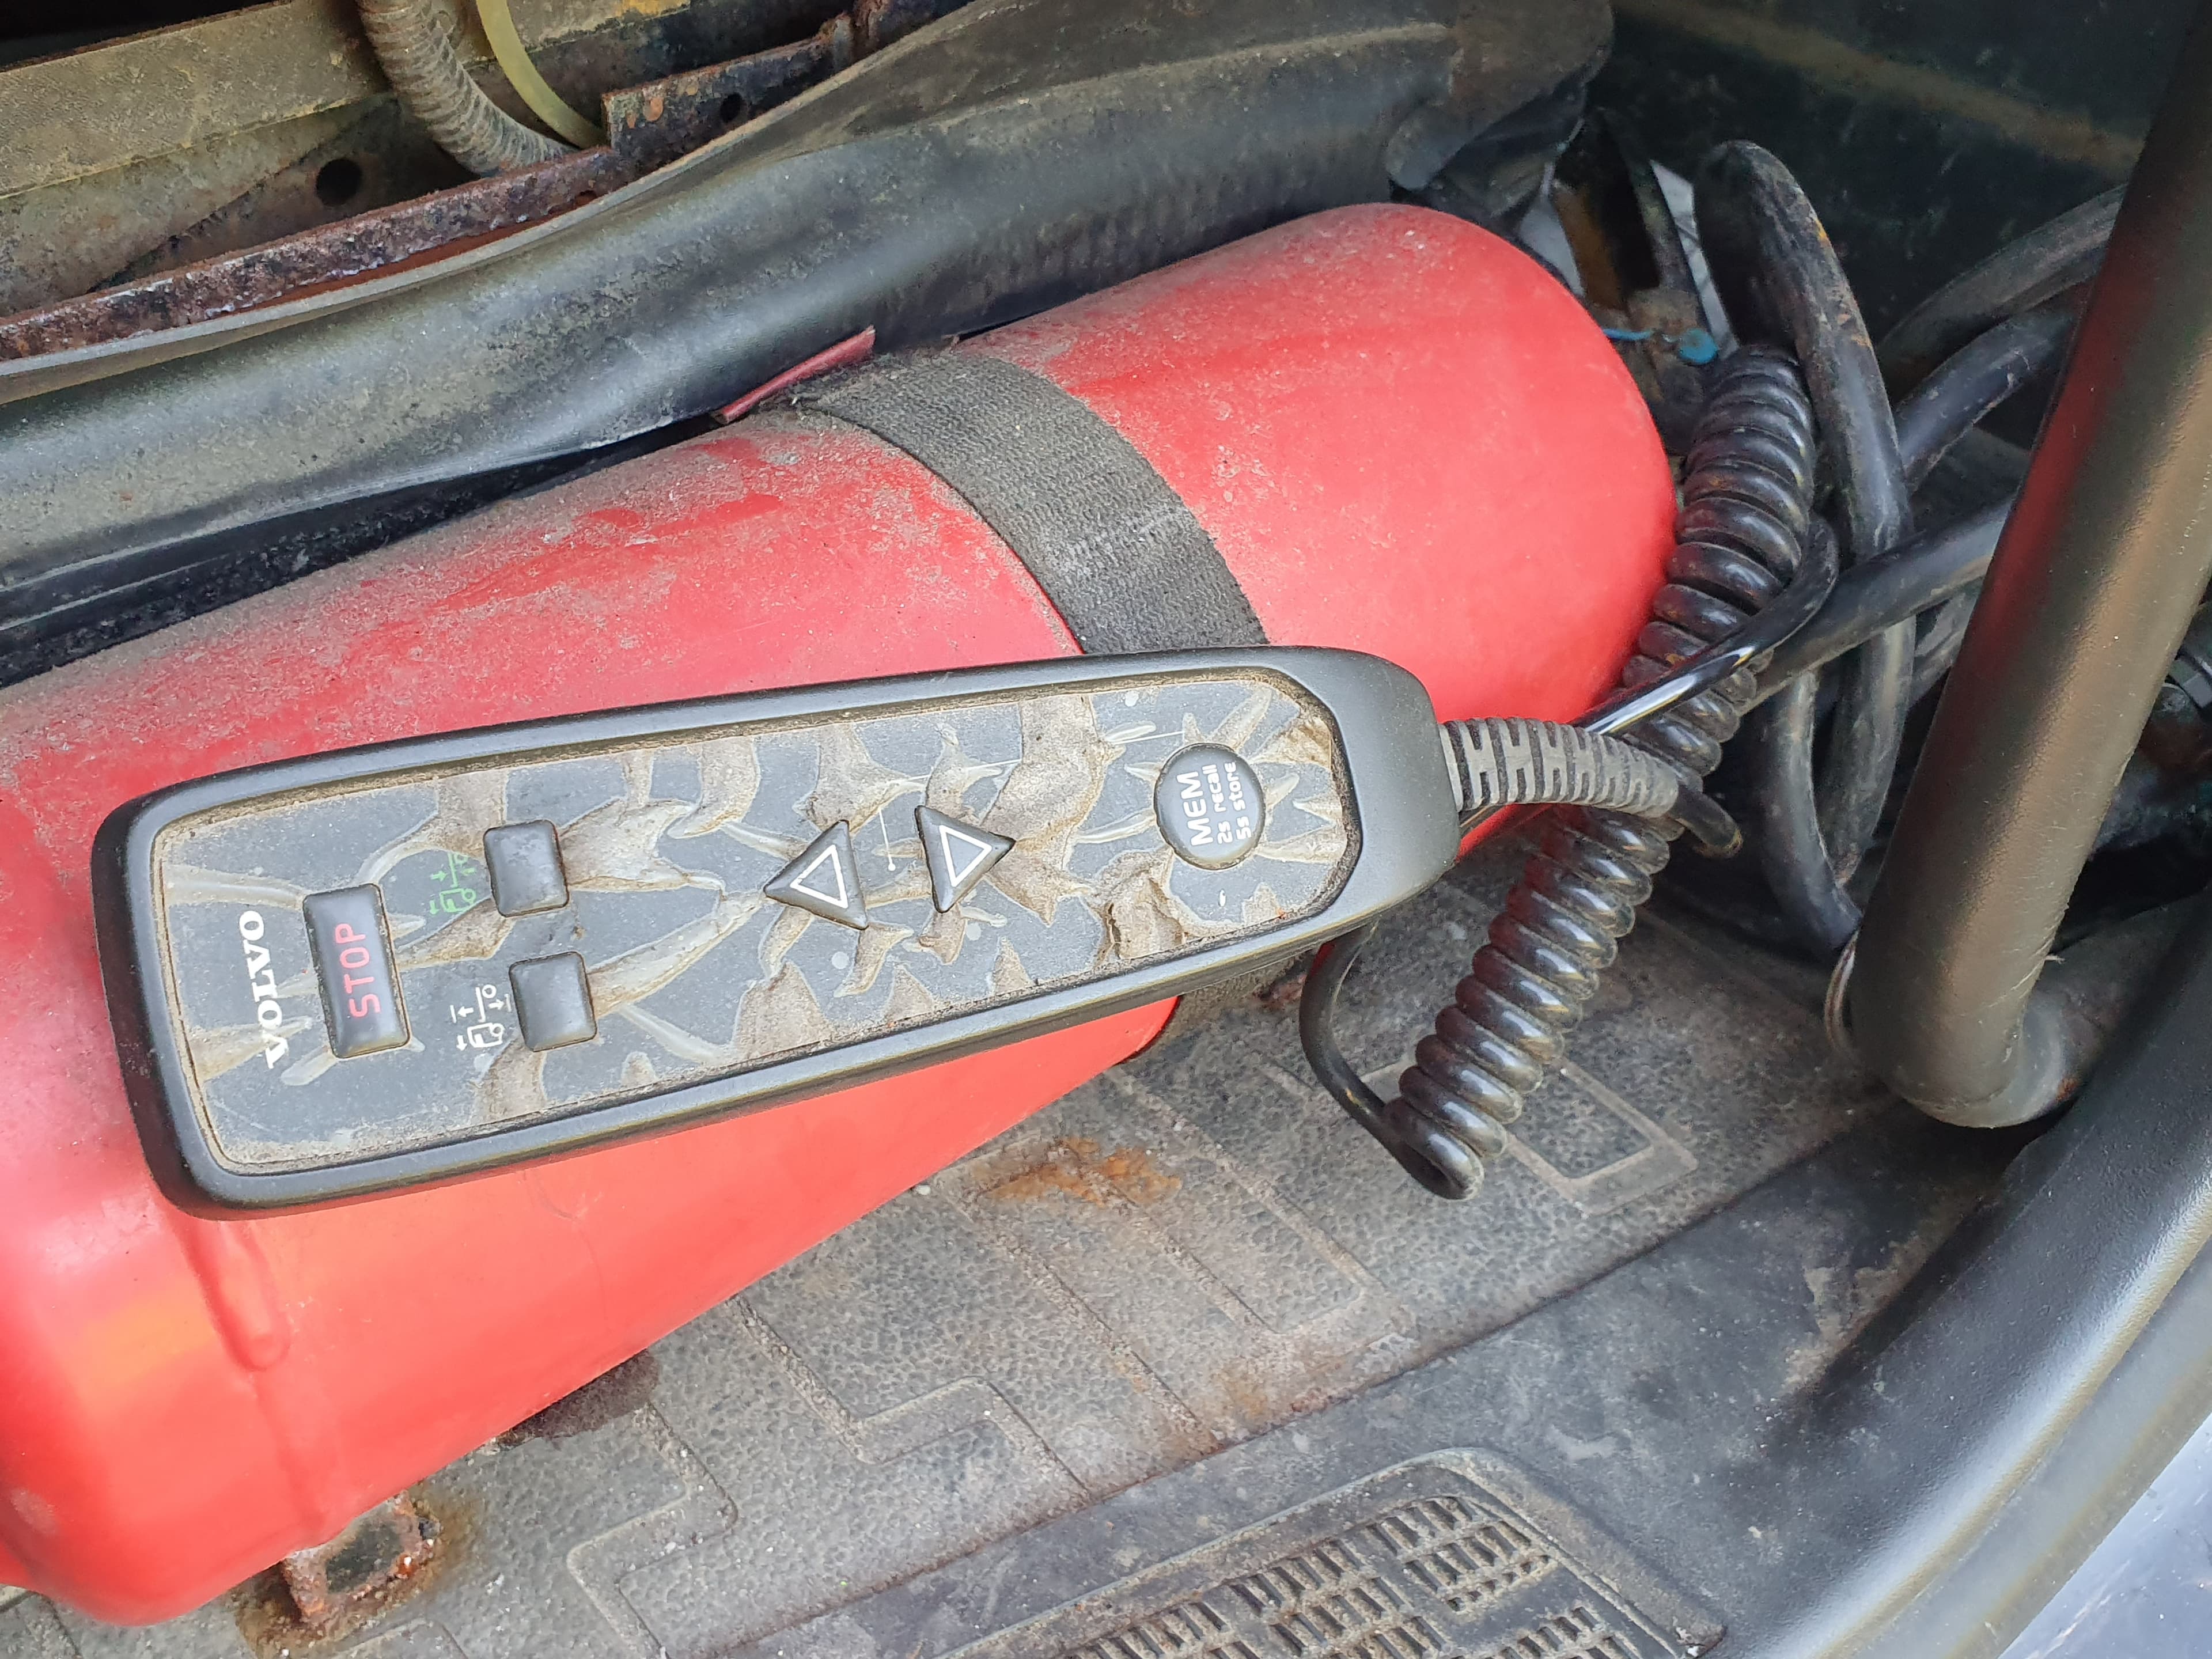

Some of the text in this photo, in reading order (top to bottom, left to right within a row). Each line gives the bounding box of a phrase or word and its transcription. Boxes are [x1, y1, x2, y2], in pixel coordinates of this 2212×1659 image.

[1176, 771, 1213, 846] MEM
[1202, 764, 1233, 844] 2s recall
[1224, 761, 1251, 839] 5s store
[239, 911, 289, 1069] VOLVO
[335, 923, 381, 1018] STOP
